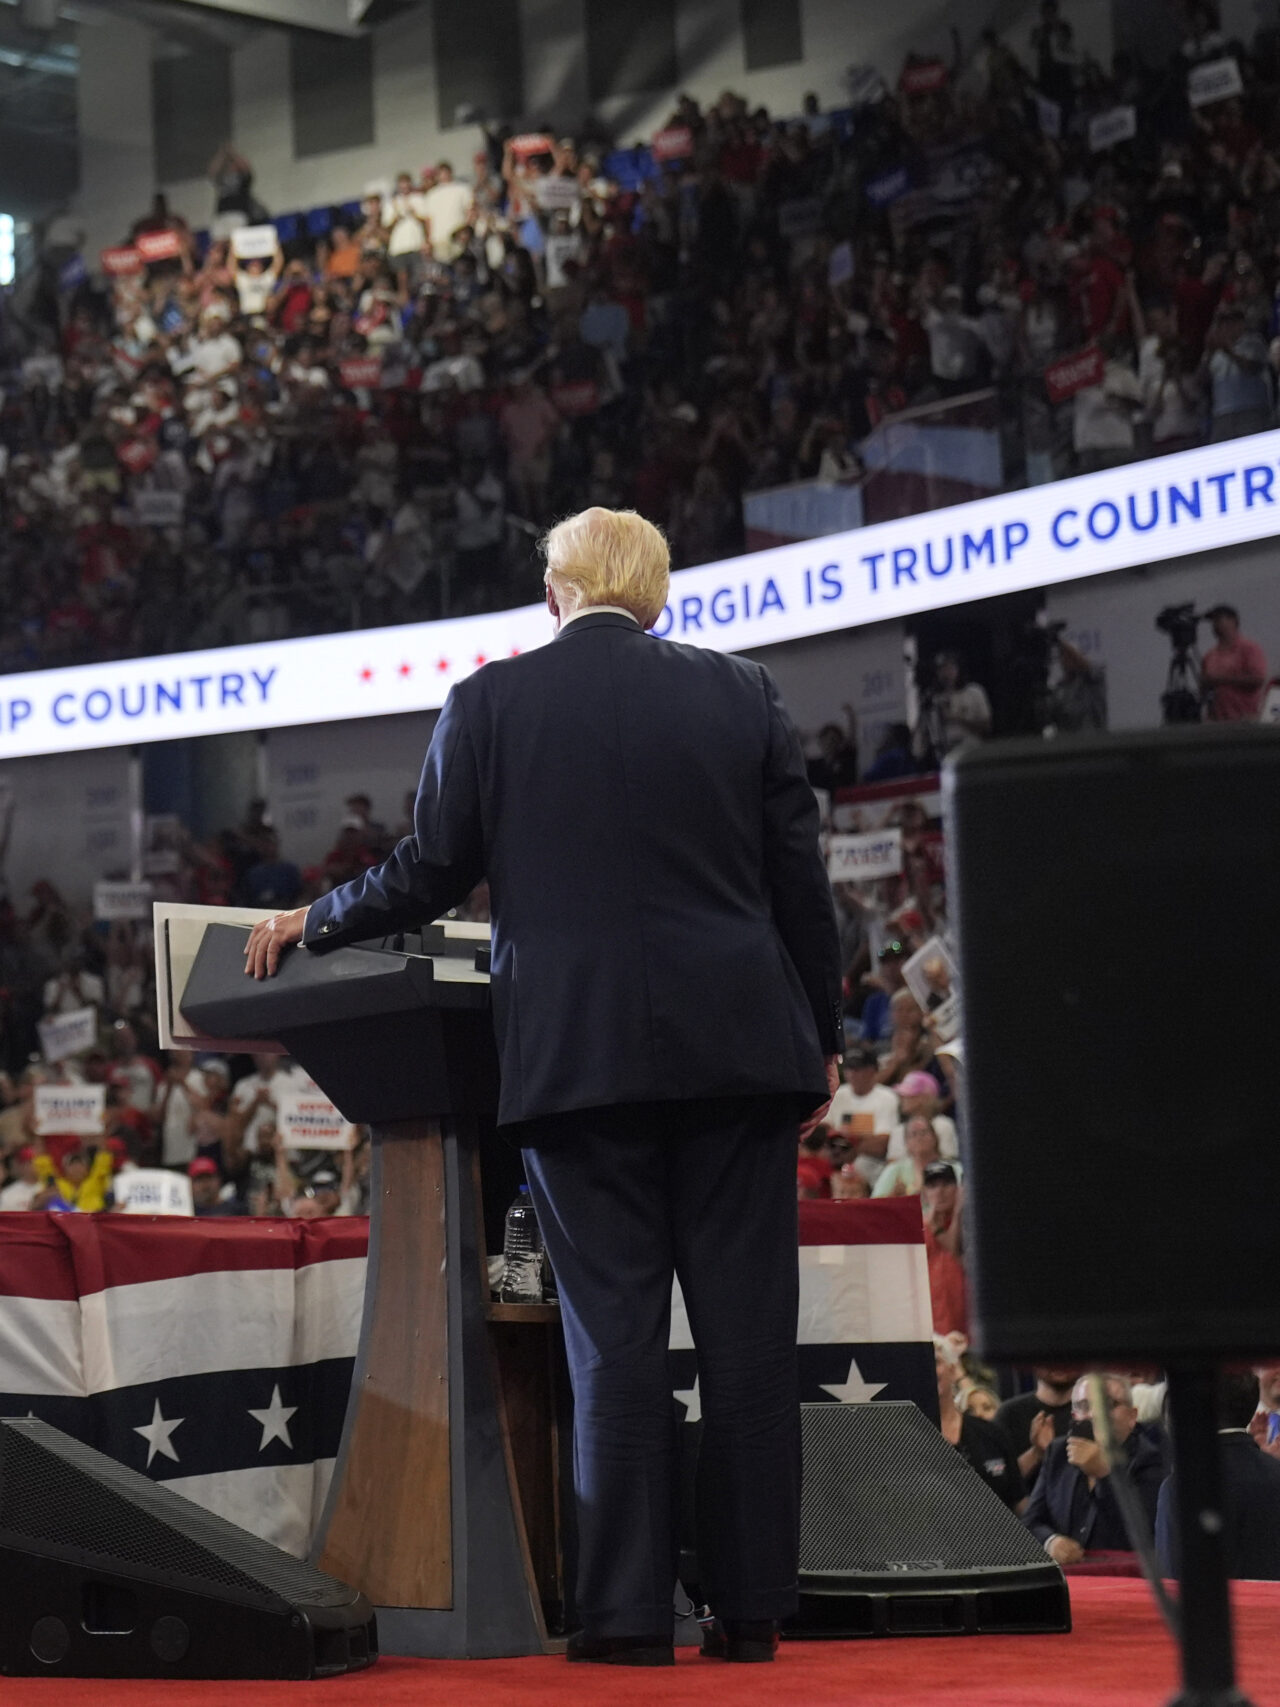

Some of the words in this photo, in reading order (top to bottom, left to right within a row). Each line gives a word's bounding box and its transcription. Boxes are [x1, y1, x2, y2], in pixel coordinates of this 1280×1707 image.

[645, 575, 788, 628] ORGIA
[803, 562, 846, 608] IS
[859, 519, 1032, 594] TRUMP
[1049, 460, 1280, 554] COUNTR
[50, 665, 278, 731] COUNTRY
